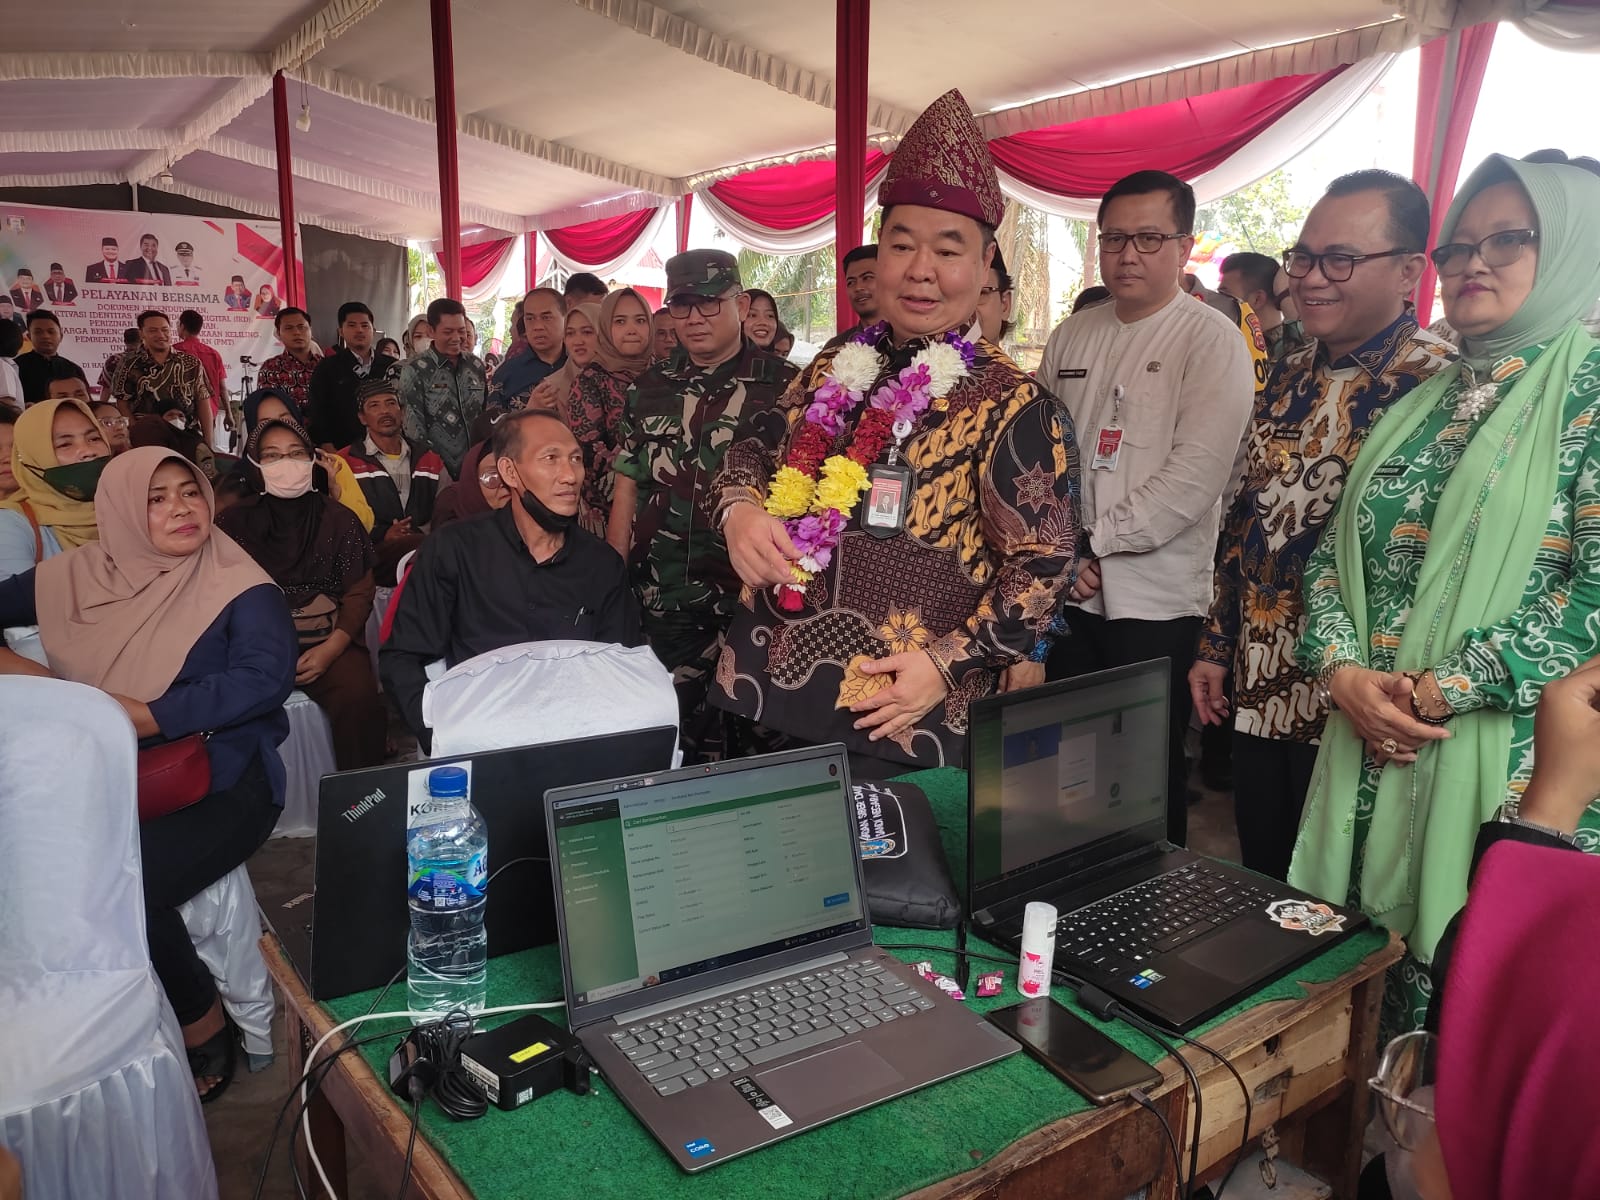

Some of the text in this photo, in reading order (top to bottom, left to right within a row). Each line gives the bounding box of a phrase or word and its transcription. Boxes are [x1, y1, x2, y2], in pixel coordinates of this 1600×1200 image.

[82, 289, 220, 304] PELAYANAN BERSAMA
[97, 303, 140, 312] DOKUMEN
[54, 310, 87, 318] KTIVASI
[89, 311, 132, 319] IDENTITAS
[89, 319, 133, 327] PERIZINAN
[61, 327, 89, 335] ARGA
[341, 787, 387, 823] ThinkPad
